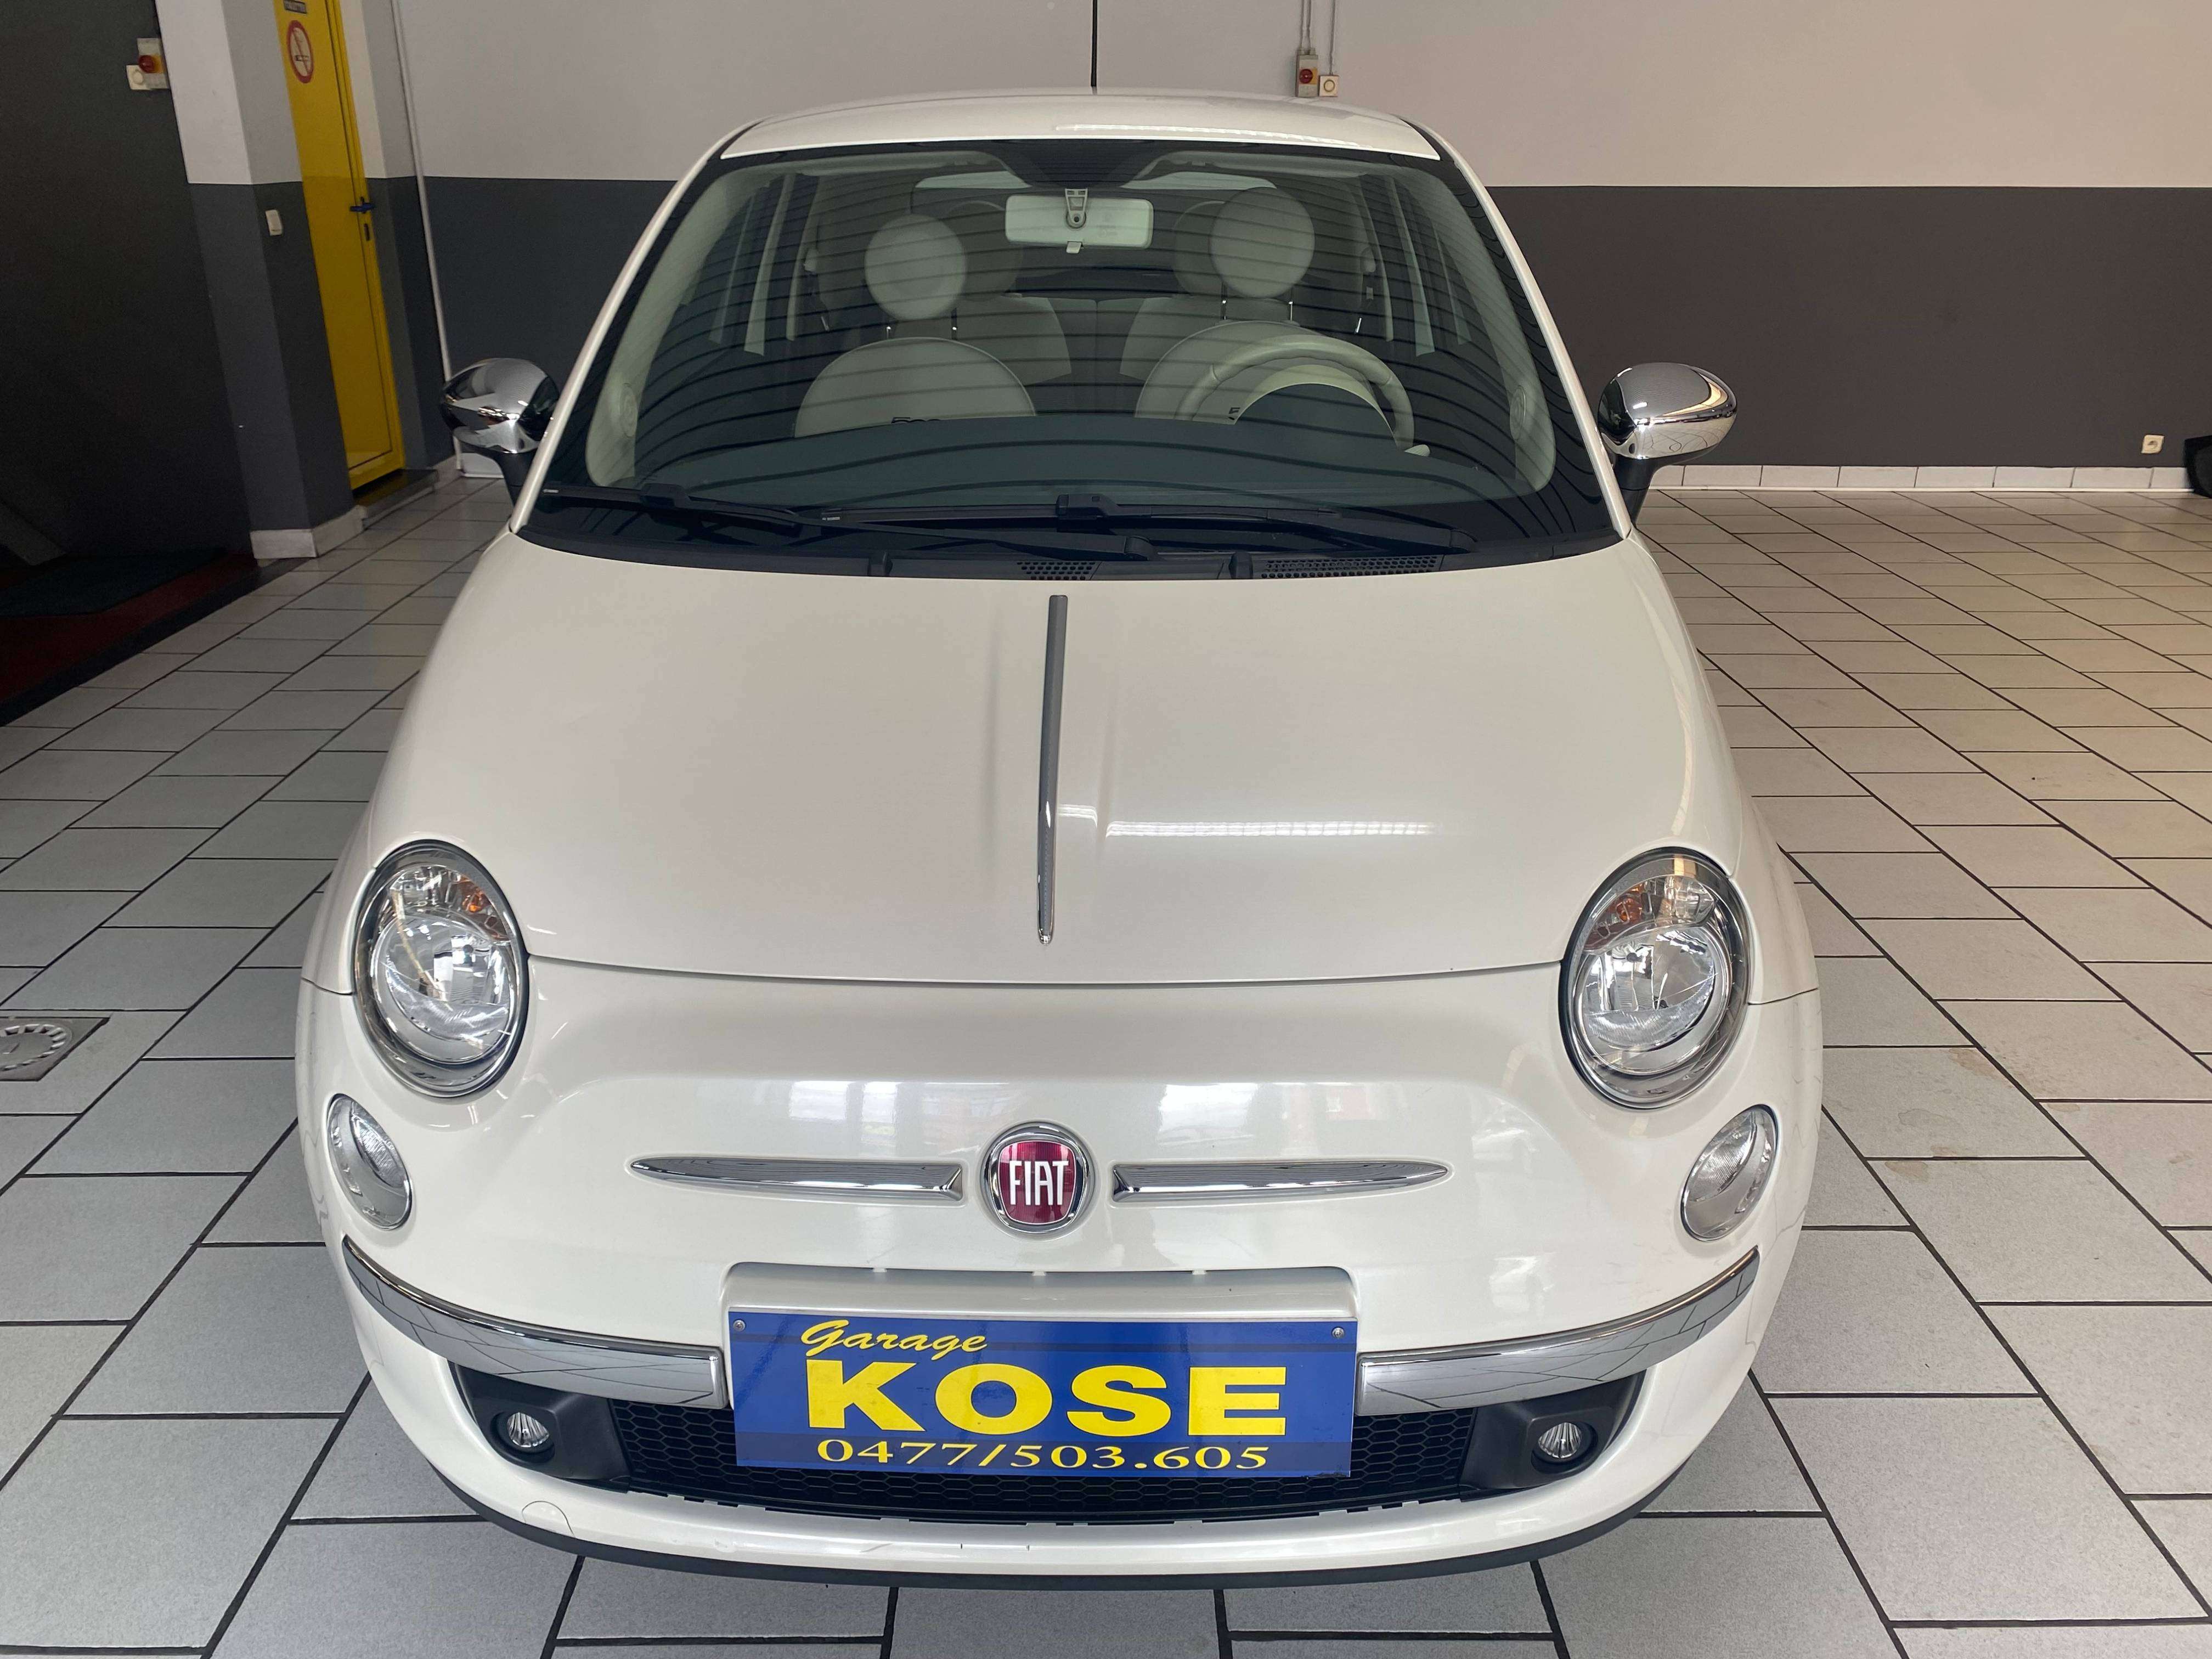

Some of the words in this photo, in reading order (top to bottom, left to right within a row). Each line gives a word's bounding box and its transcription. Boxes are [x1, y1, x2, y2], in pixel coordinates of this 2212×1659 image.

[1009, 1160, 1069, 1206] FIAT
[800, 1319, 988, 1361] Garage
[806, 1358, 1287, 1437] KOSE
[817, 1439, 1269, 1470] 0477/503.605
